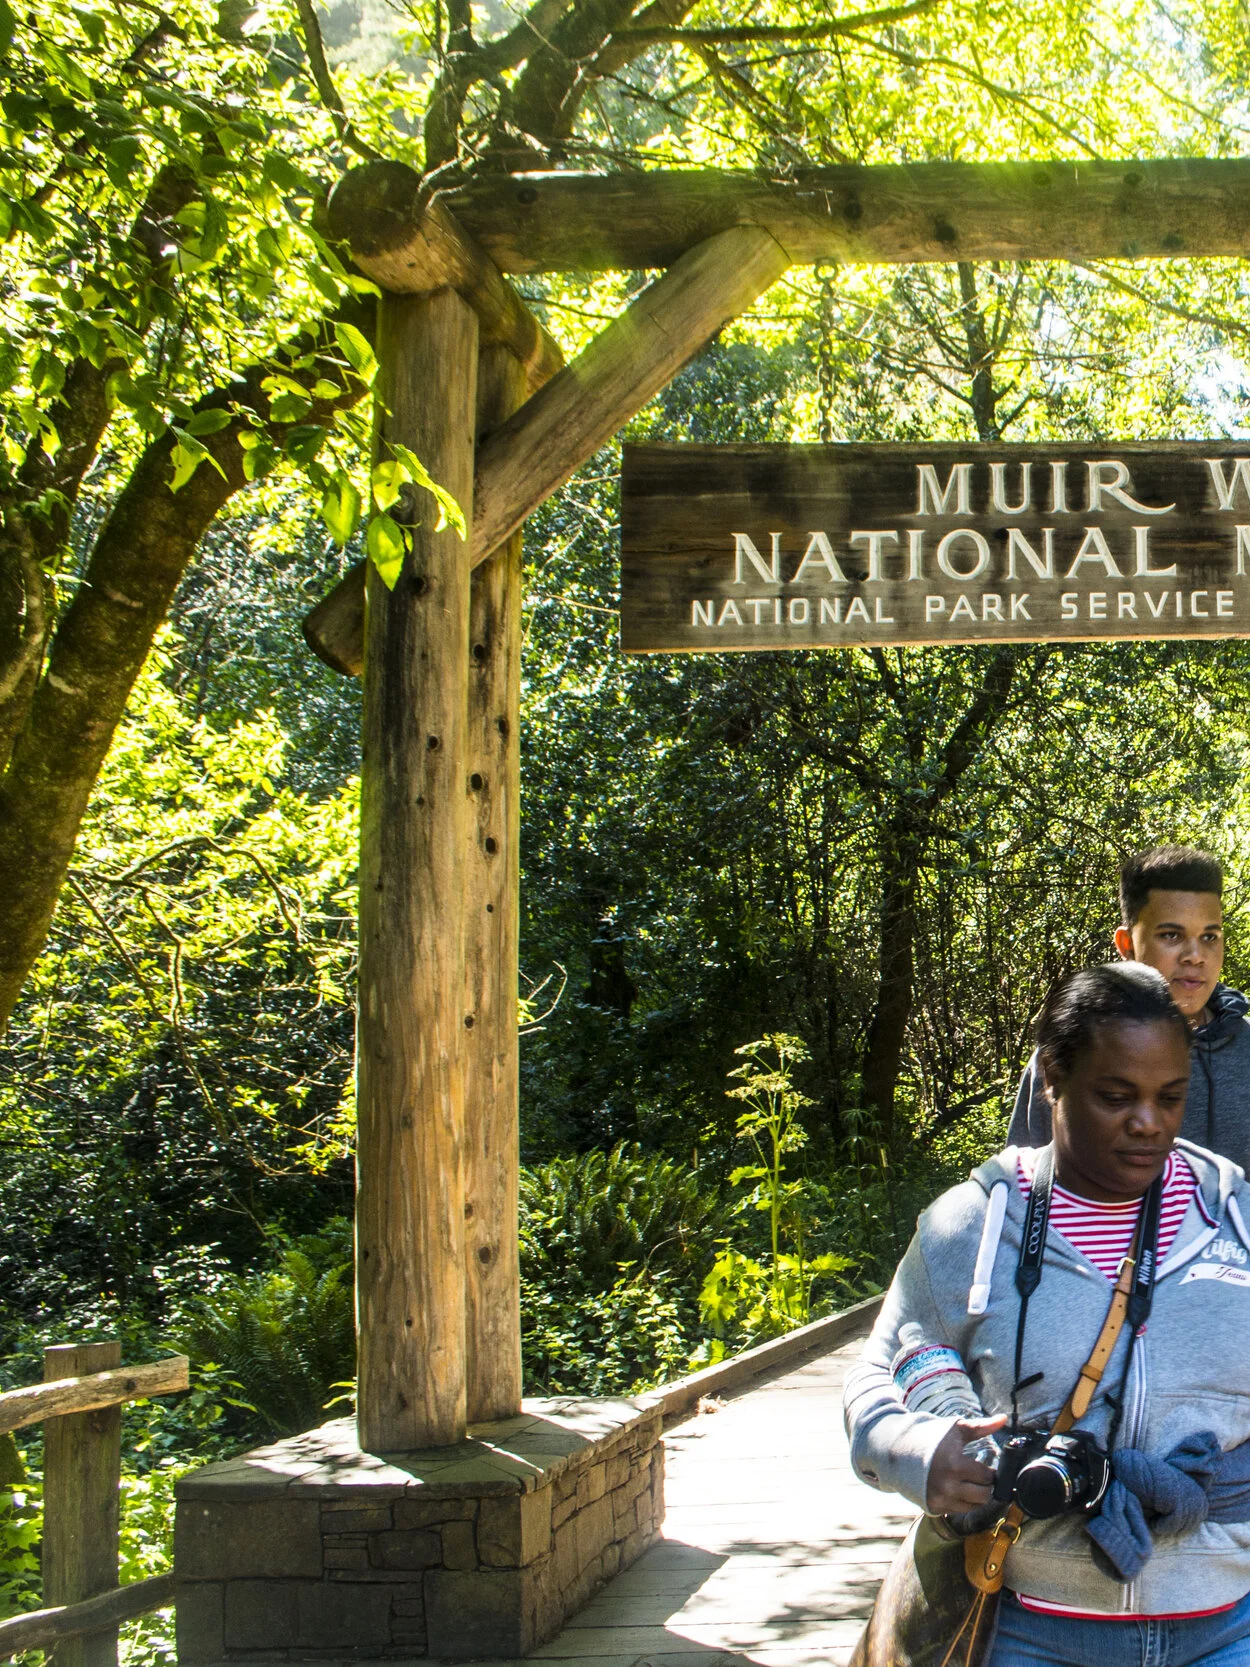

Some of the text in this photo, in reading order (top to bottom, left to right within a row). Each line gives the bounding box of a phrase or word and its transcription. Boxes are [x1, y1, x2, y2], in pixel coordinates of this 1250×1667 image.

[916, 460, 1177, 516] MUIR
[731, 526, 1178, 584] NATIONAL
[692, 596, 894, 627] NATIONAL
[926, 593, 1032, 623] PARK
[1061, 589, 1234, 620] SERVICE
[1138, 1249, 1153, 1286] Nikon
